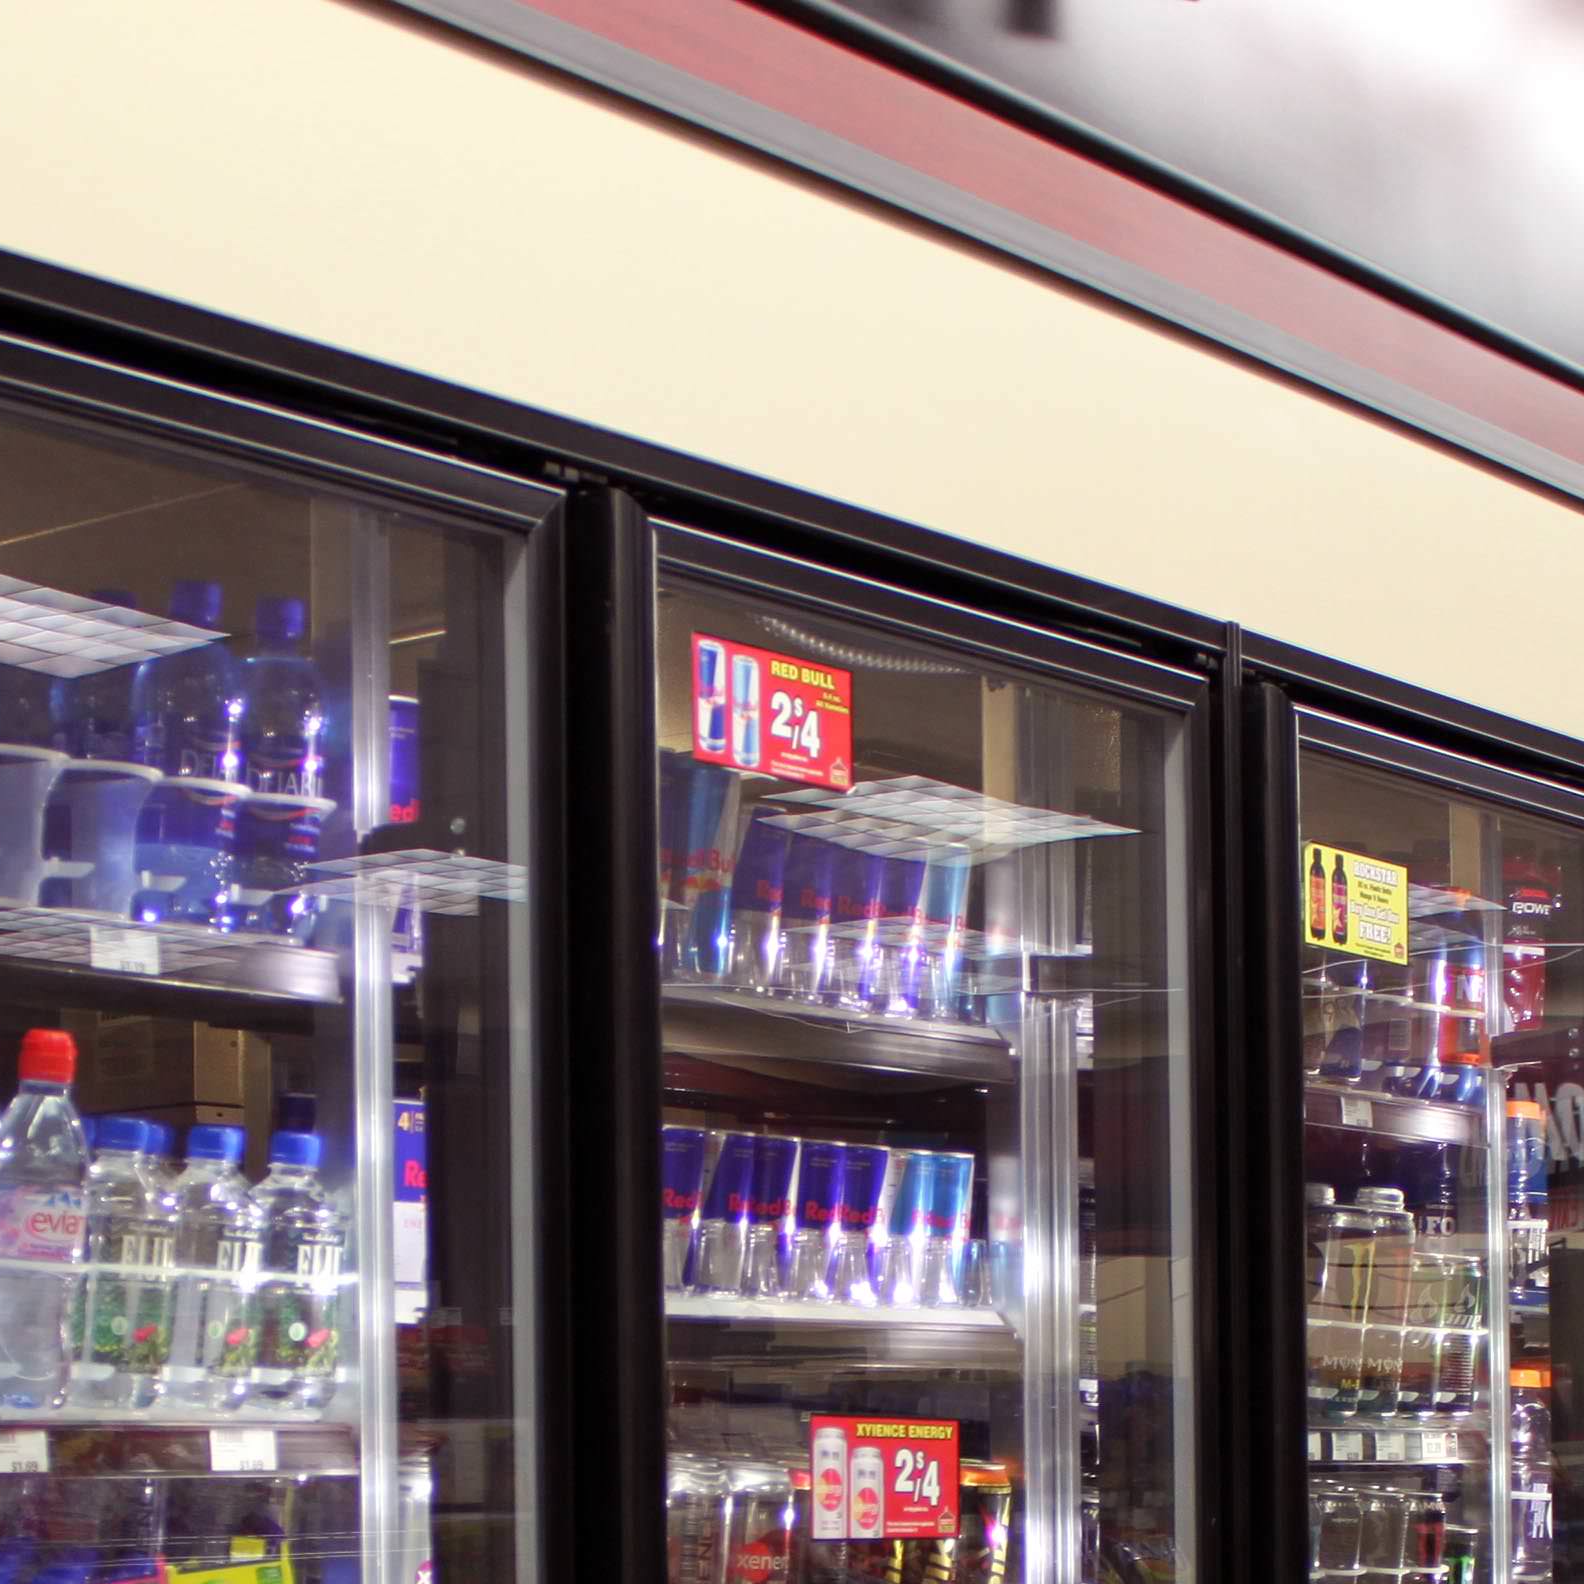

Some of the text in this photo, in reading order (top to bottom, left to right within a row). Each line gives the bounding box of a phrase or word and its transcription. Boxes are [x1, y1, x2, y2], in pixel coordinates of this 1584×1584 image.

[770, 658, 836, 691] RED BULL
[1359, 920, 1392, 944] FREE!
[28, 1207, 82, 1235] evia
[856, 1423, 953, 1441] XYIENCE ENERGY
